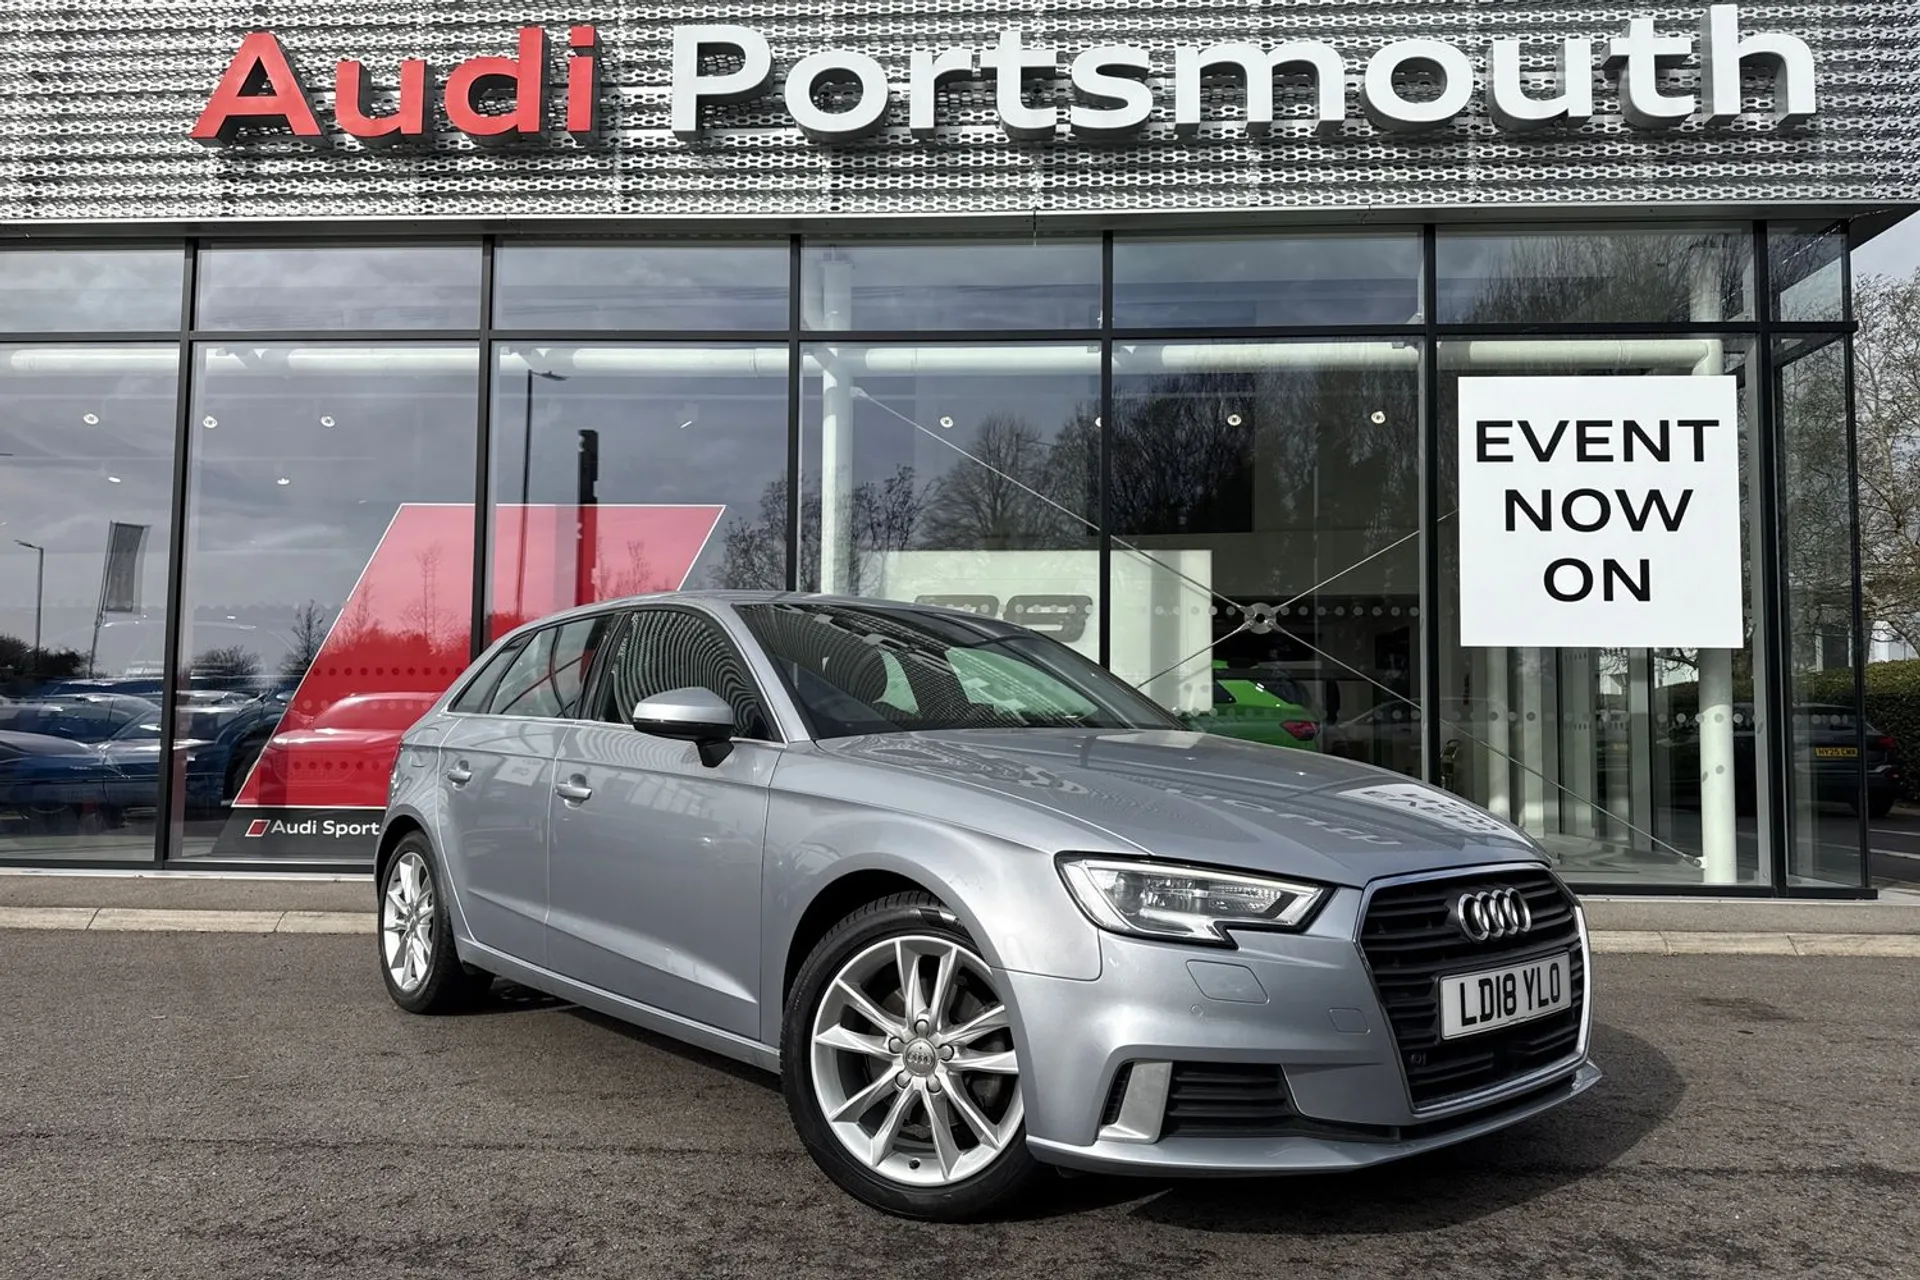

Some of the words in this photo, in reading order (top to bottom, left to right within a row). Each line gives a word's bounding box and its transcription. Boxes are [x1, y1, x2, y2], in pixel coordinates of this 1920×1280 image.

[192, 26, 597, 138] Audi
[671, 4, 1816, 132] Portsmouth
[1476, 419, 1720, 463] EVENT
[1505, 488, 1694, 533] NOW
[1543, 557, 1651, 602] ON
[270, 819, 318, 835] Audi
[322, 820, 381, 839] Sport
[1460, 973, 1517, 1027] LD18
[1523, 962, 1561, 1011] YLO
